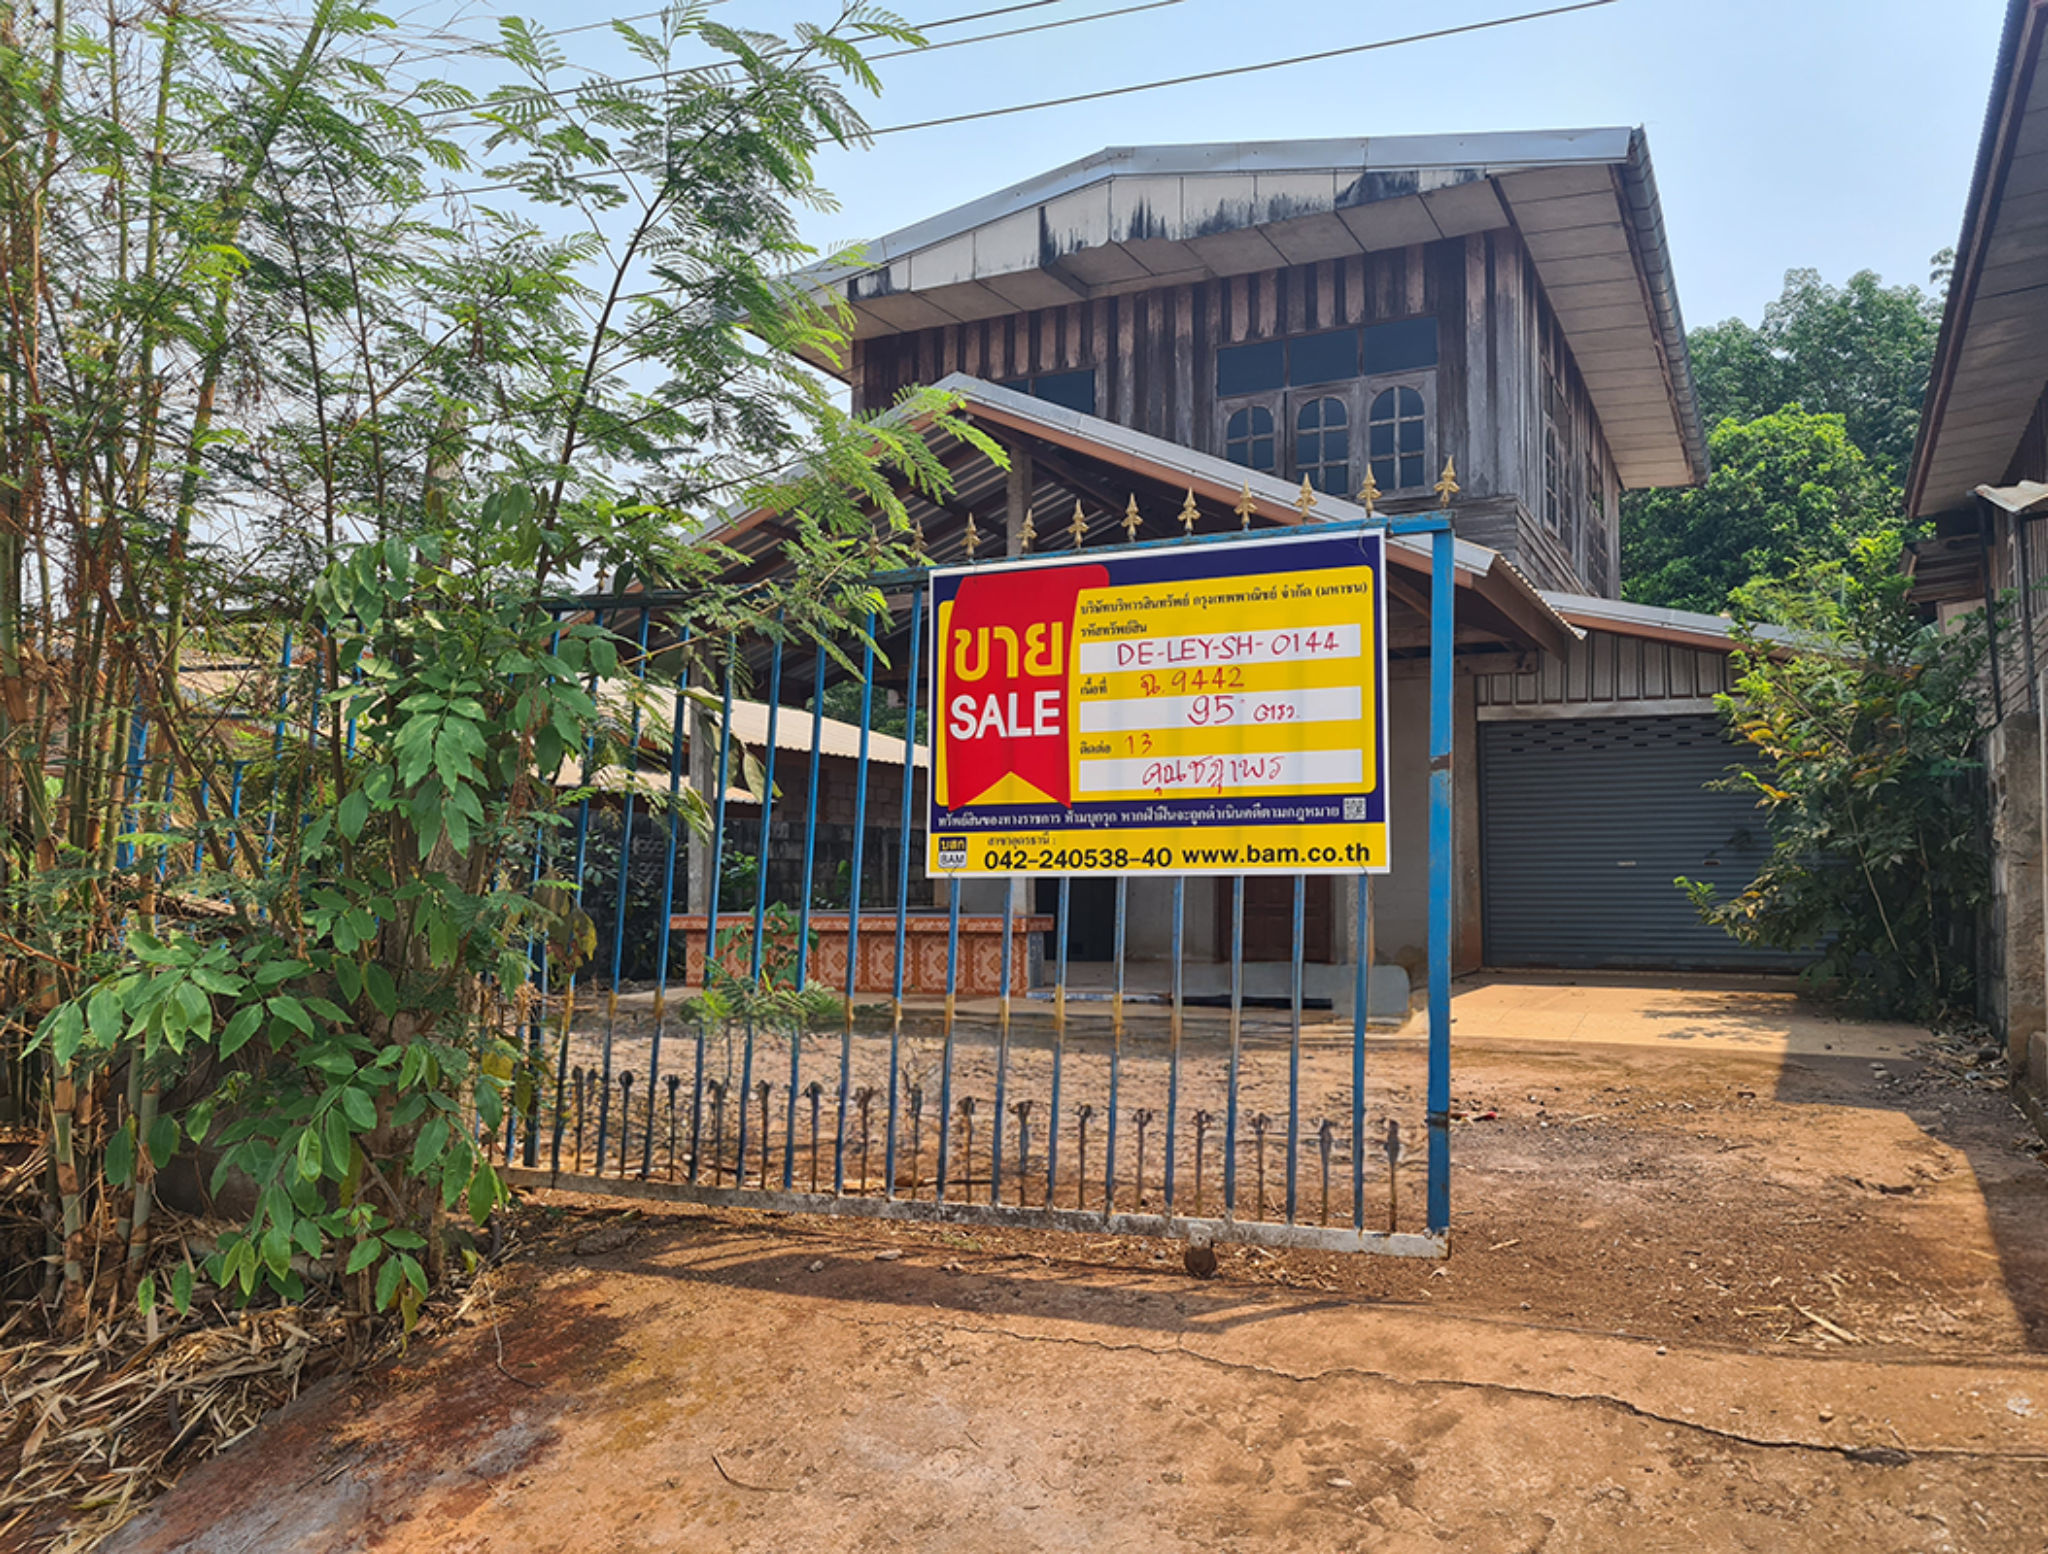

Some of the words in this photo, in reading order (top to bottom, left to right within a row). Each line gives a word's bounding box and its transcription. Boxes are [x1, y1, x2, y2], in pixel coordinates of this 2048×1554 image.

[1282, 583, 1312, 599] จำกัด
[1315, 581, 1368, 597] (มหาชน)
[954, 621, 1063, 682] ขาย
[1171, 666, 1245, 693] 9442
[950, 690, 1061, 740] SALE
[1125, 732, 1153, 755] 13
[939, 853, 965, 864] BAM
[984, 847, 1173, 870] 042-240538-40
[1182, 842, 1371, 864] www.bam.co.th
